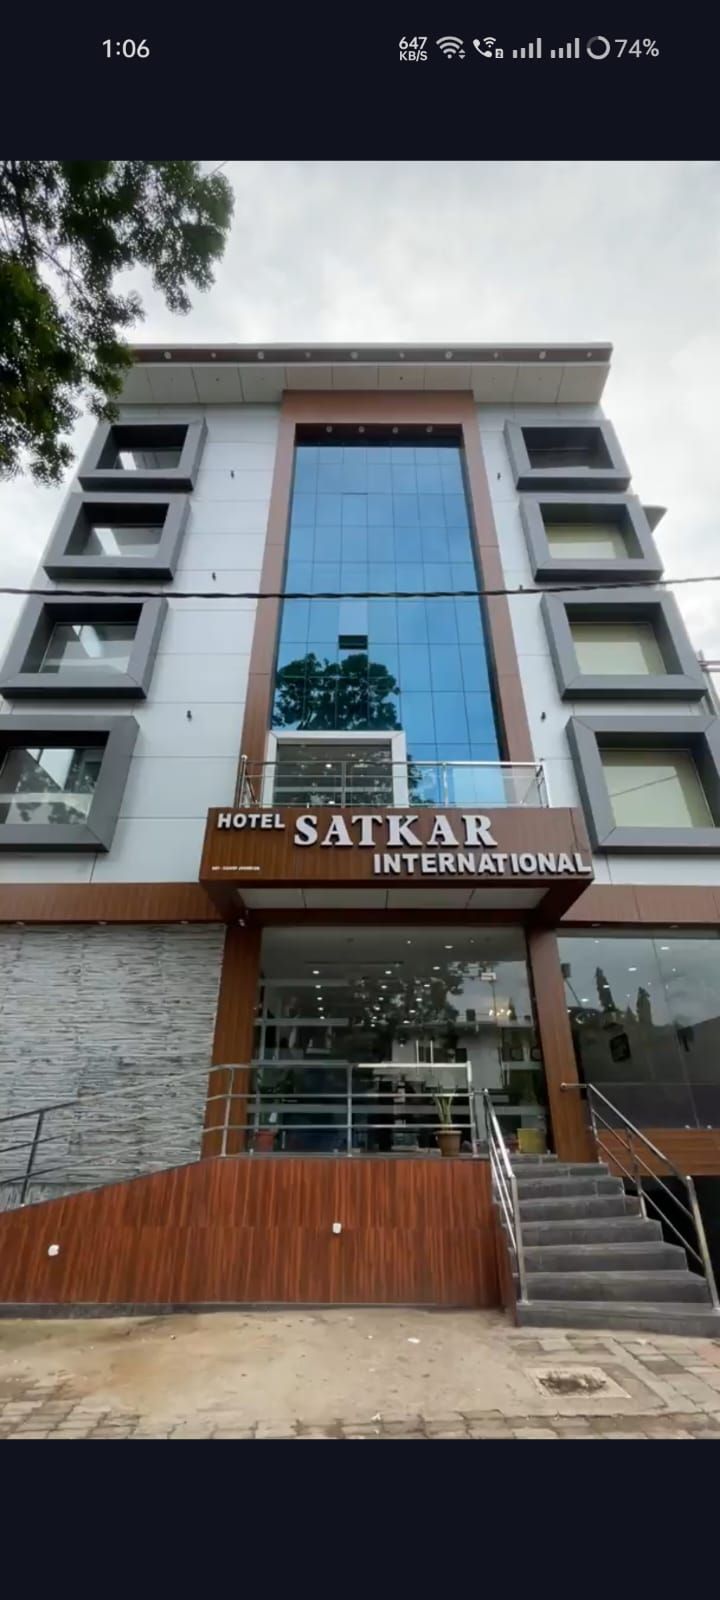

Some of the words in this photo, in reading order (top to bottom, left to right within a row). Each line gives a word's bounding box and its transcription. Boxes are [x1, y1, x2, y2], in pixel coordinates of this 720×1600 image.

[217, 812, 285, 830] HOTEL
[293, 814, 498, 848] SATKAR
[373, 852, 591, 875] INTERNATIONAL
